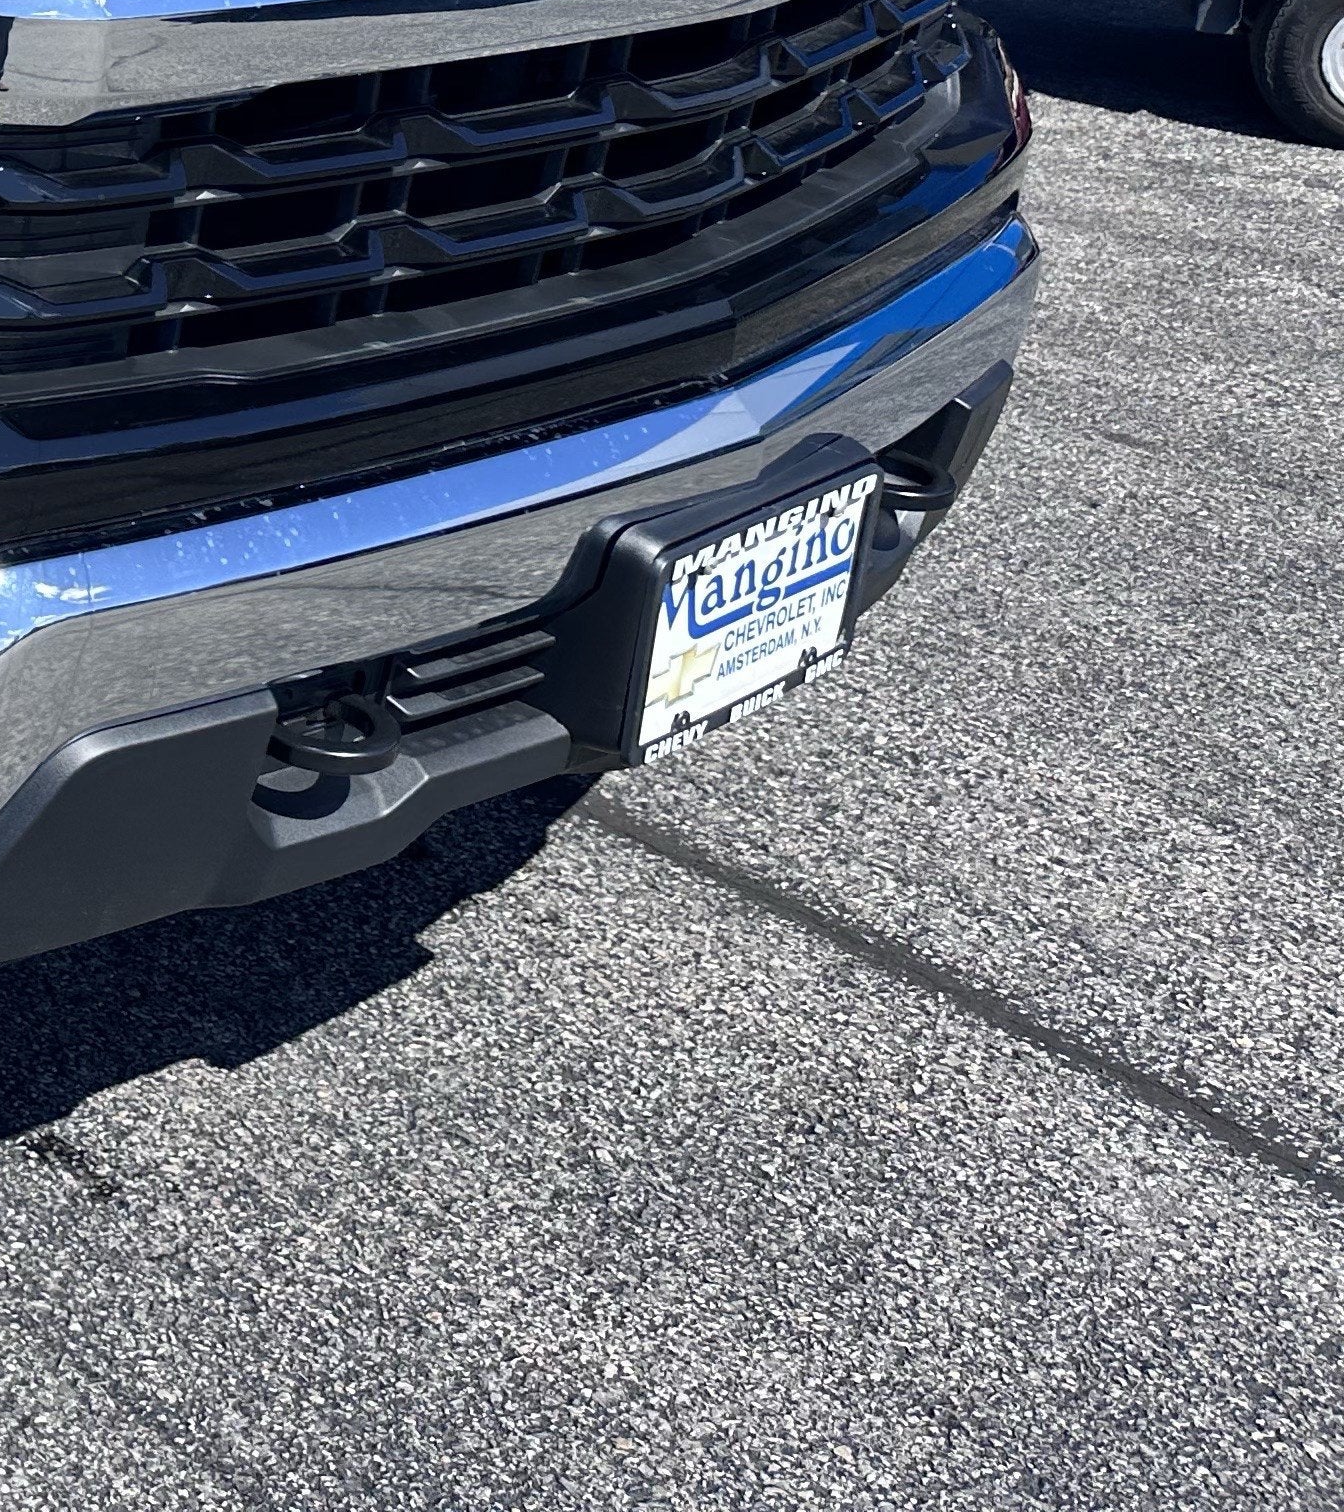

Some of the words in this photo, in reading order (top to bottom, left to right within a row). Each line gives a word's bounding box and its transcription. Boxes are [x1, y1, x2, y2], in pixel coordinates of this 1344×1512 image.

[672, 473, 878, 582] MANGINO
[661, 517, 856, 640] Mangino
[723, 591, 816, 652] CHEVROLET,
[804, 649, 845, 685] GMC
[729, 680, 788, 724] BUICK
[643, 719, 709, 765] CHEVY
